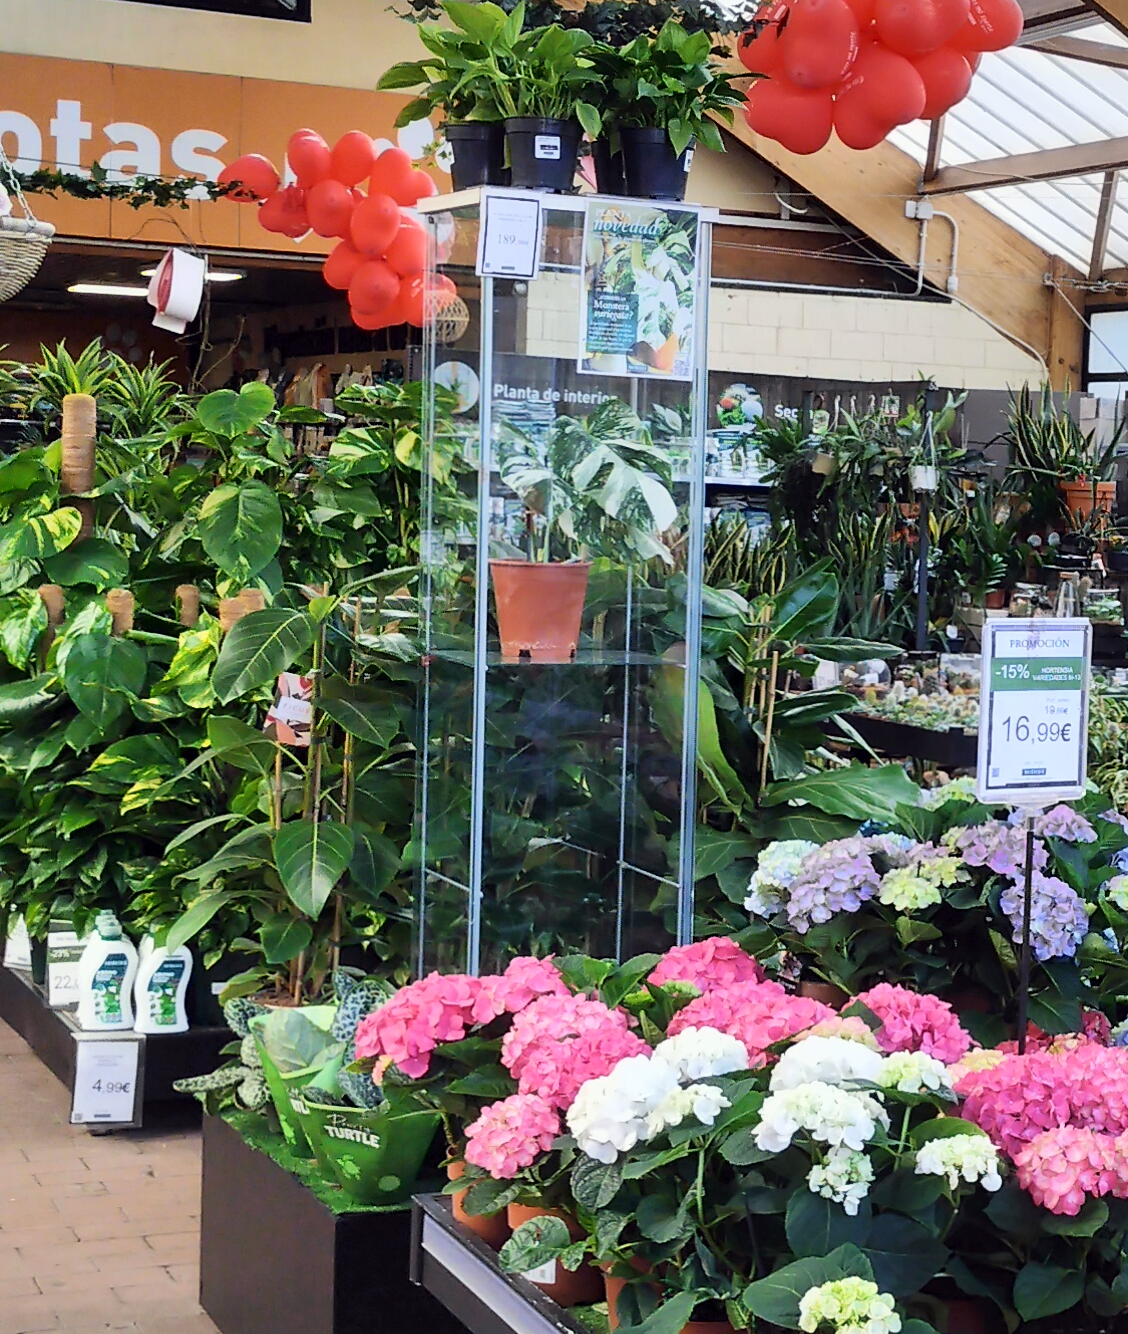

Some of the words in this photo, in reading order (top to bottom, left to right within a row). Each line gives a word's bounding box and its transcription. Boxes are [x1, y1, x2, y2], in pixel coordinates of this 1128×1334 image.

[593, 216, 660, 236] novedad
[493, 384, 540, 400] Planta
[542, 388, 560, 402] de
[1009, 637, 1071, 648] PROMOCIÓN
[995, 663, 1030, 679] -15%
[1002, 715, 1072, 745] 16,99€
[323, 1124, 381, 1150] TURTLE
